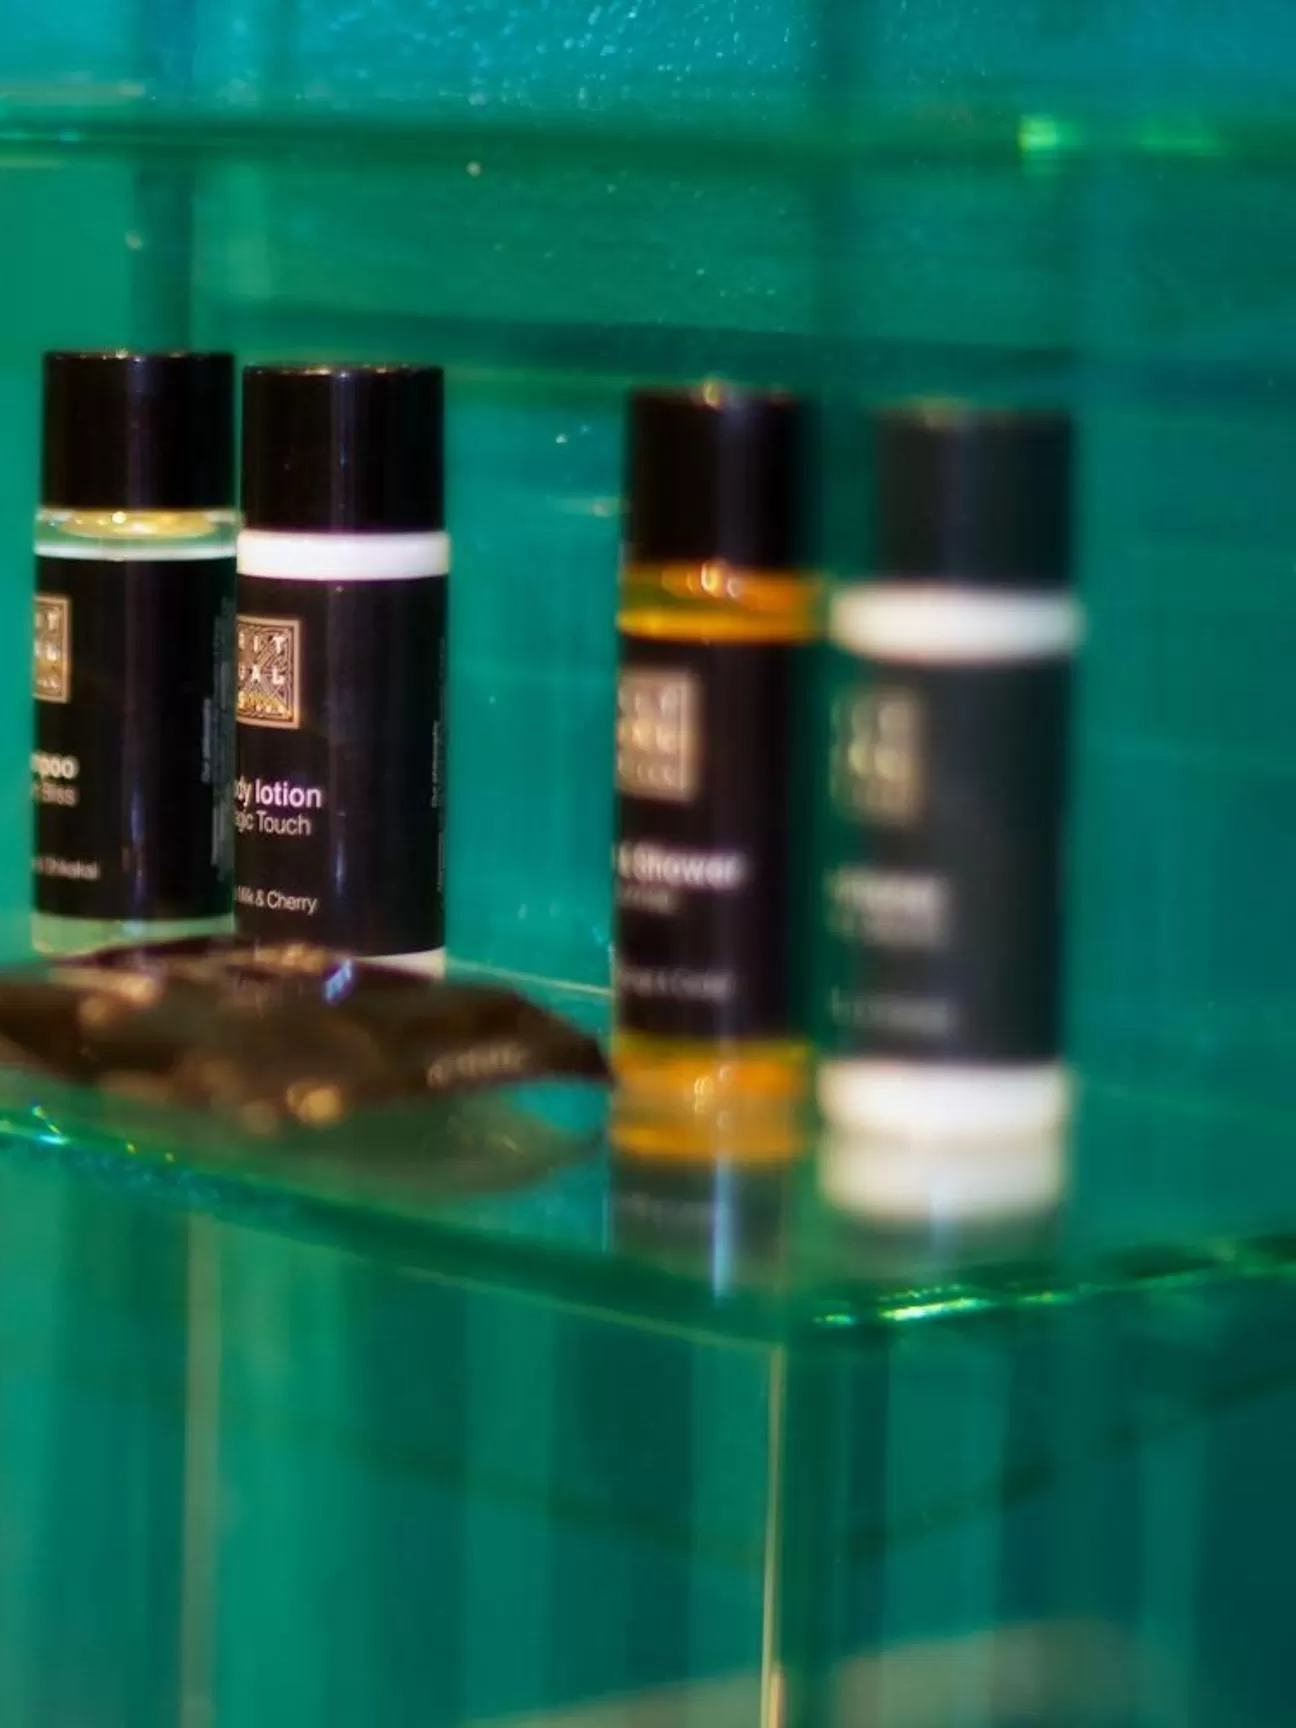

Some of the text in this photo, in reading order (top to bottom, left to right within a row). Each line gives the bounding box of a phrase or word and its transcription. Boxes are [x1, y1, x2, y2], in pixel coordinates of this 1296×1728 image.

[255, 778, 322, 808] lotion
[256, 809, 312, 837] Touch
[267, 890, 318, 916] Cherry
